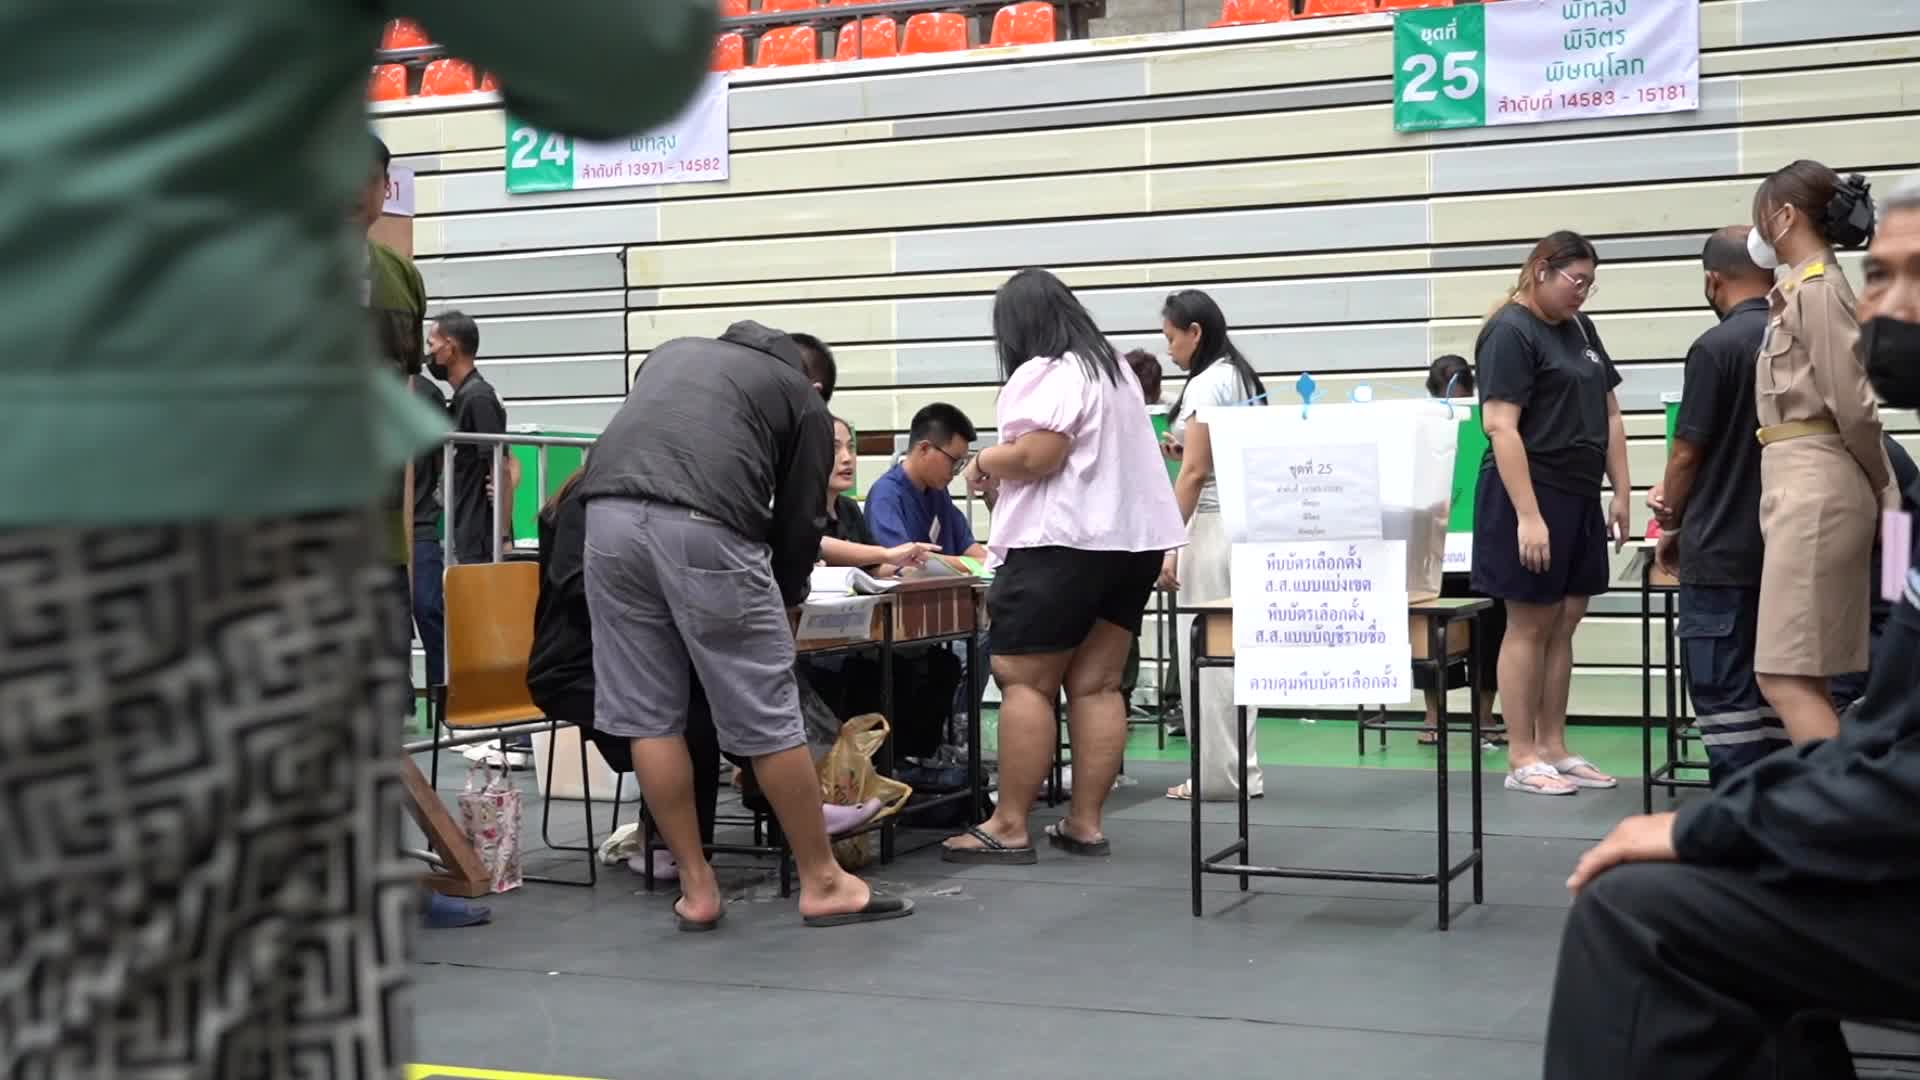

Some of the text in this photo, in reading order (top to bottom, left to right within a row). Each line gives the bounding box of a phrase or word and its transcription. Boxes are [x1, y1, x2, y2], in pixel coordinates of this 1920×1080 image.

[1562, 0, 1627, 22] พทลุง
[1421, 19, 1458, 46] ชุดที่
[1563, 27, 1626, 50] พิจิตร
[1401, 50, 1479, 102] 25
[1545, 51, 1645, 84] พิษณุโลก
[1497, 92, 1553, 113] ลำดับที่
[1560, 91, 1616, 109] 14583
[1637, 85, 1687, 103] 15181
[511, 127, 570, 169] 24
[629, 134, 677, 156] พทลุง
[582, 160, 623, 179] ลำดับที่
[628, 161, 664, 176] 13971
[680, 157, 720, 171] 14582
[1318, 463, 1333, 475] 25
[1265, 544, 1362, 571] หีบบัตรเลือกตั้ง
[1267, 598, 1365, 622] หีบบัตรเลือกตั้ง
[1249, 664, 1398, 696] ควบคุมหีบบัตรเลือกตั้ง
